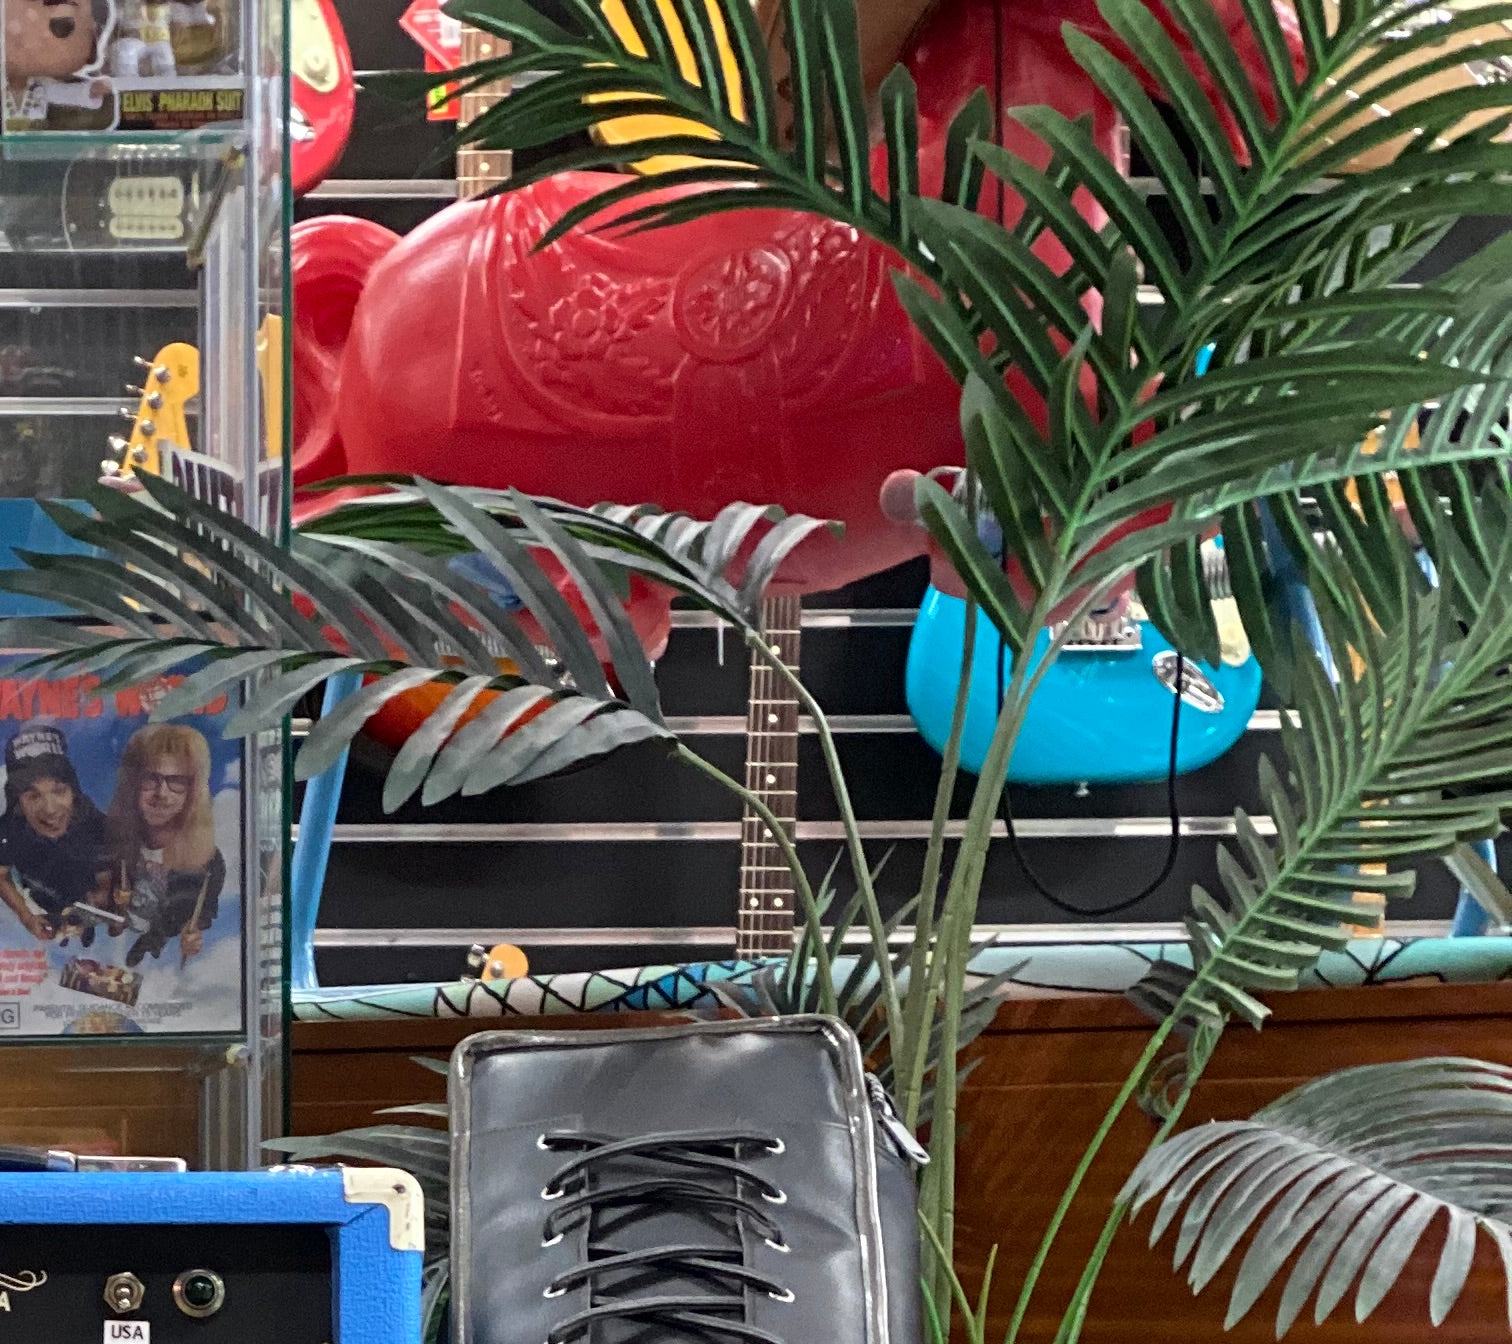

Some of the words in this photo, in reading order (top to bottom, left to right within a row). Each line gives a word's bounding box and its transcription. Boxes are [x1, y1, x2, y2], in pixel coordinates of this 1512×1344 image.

[123, 91, 153, 112] ELVIS
[216, 89, 242, 111] SUIT
[111, 1325, 144, 1340] USA
